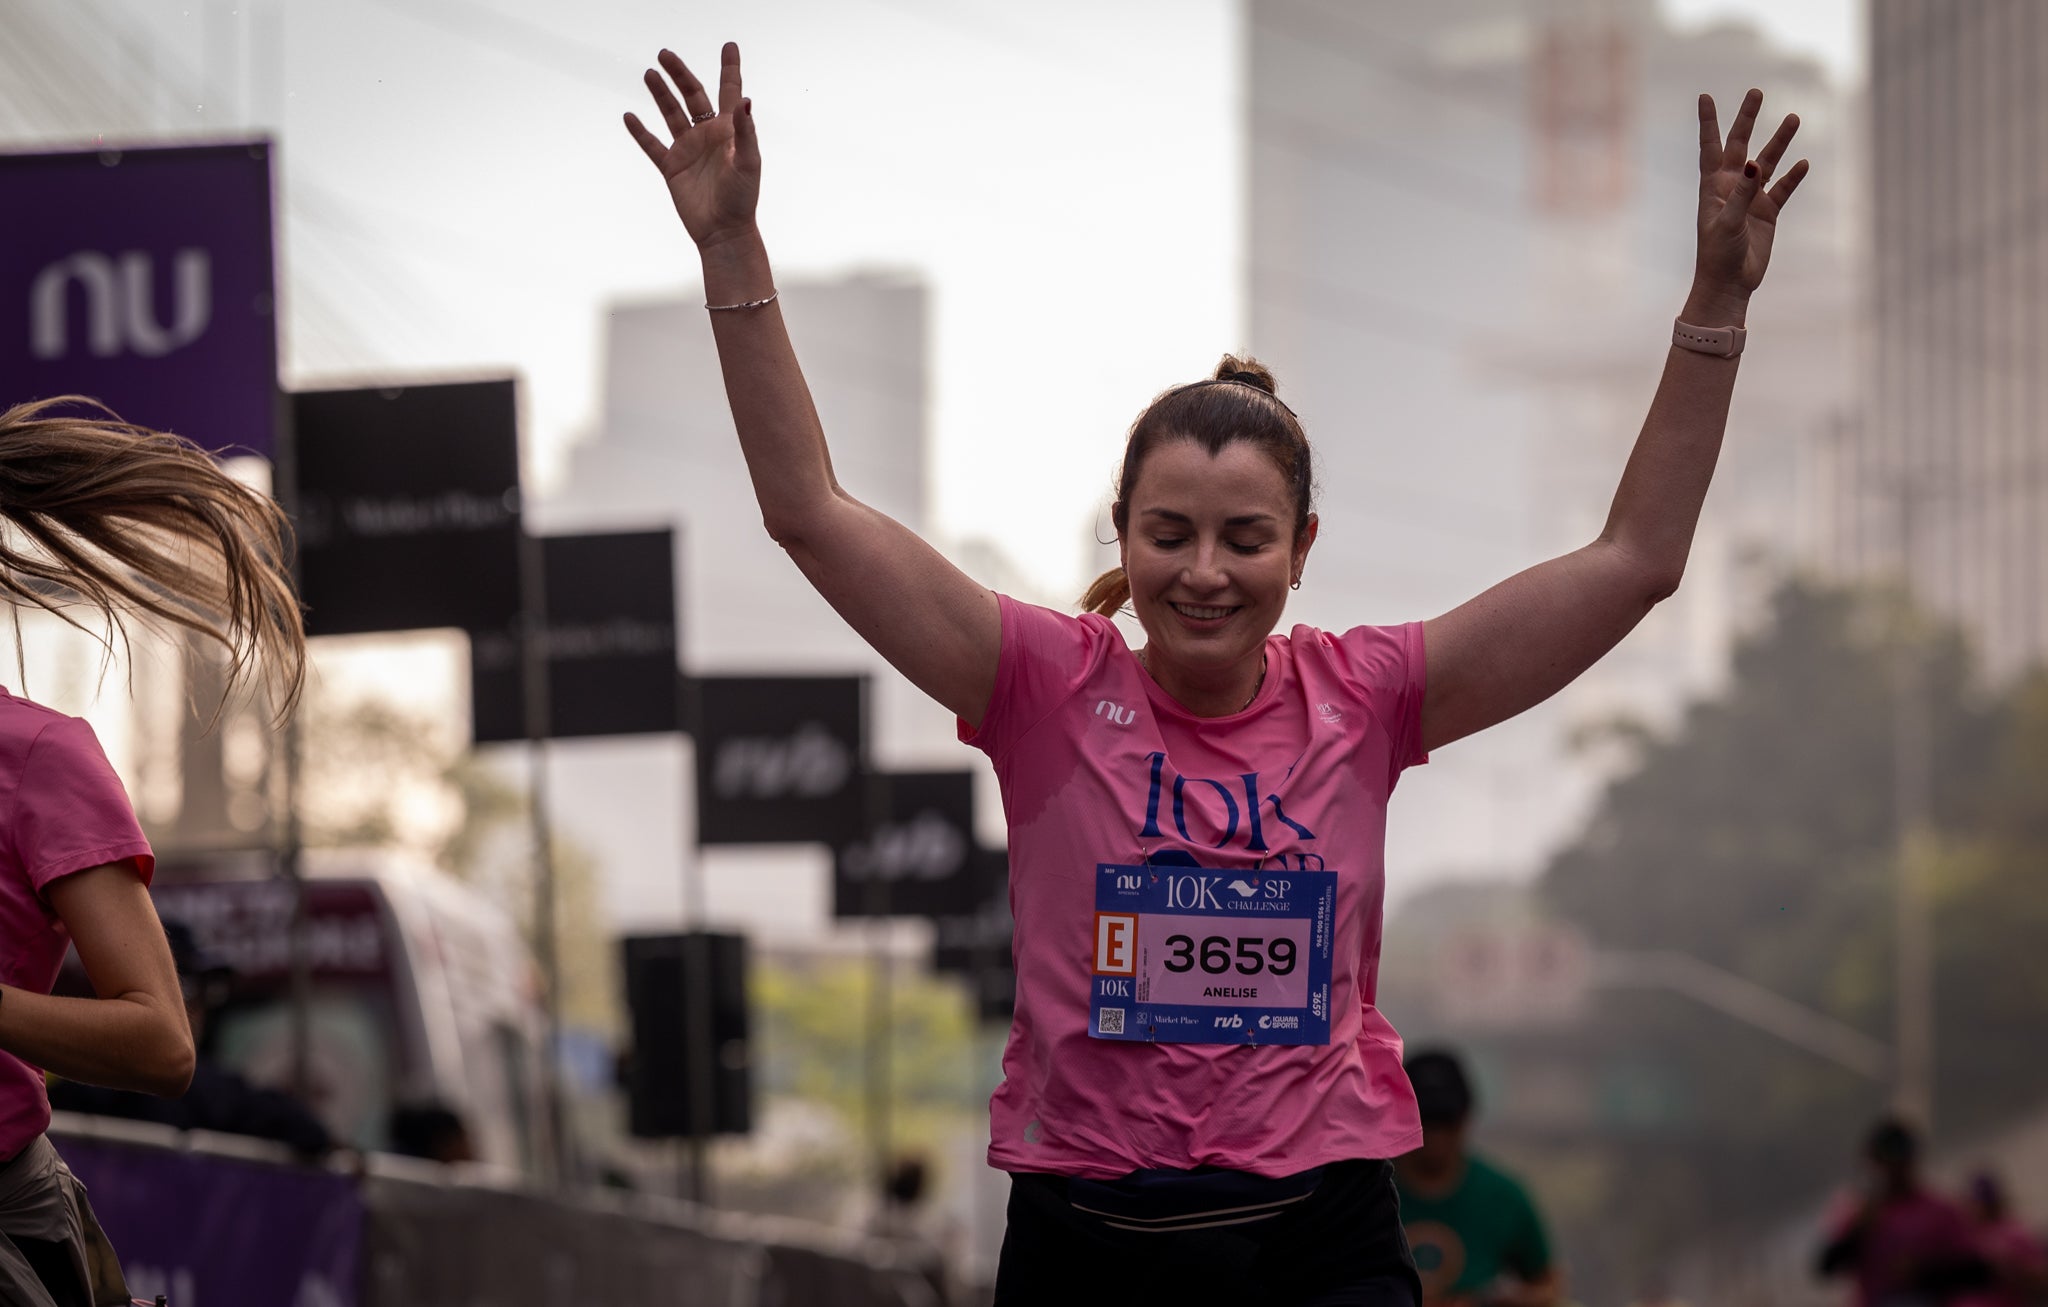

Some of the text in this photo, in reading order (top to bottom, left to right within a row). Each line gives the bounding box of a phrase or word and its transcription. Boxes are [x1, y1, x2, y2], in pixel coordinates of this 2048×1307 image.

[1095, 700, 1136, 725] nu
[1138, 752, 1316, 850] 10K
[1117, 875, 1142, 889] nu
[1264, 880, 1291, 898] SP
[1166, 876, 1223, 909] 10K
[1227, 901, 1290, 911] CHALLENGE
[1107, 923, 1125, 967] E
[1164, 934, 1297, 976] 3659
[1099, 979, 1131, 997] 10K
[1203, 987, 1258, 998] ANELISE
[1312, 992, 1322, 1016] 3659
[1154, 1015, 1178, 1024] Market
[1180, 1016, 1200, 1025] Place
[1213, 1014, 1243, 1028] rvb
